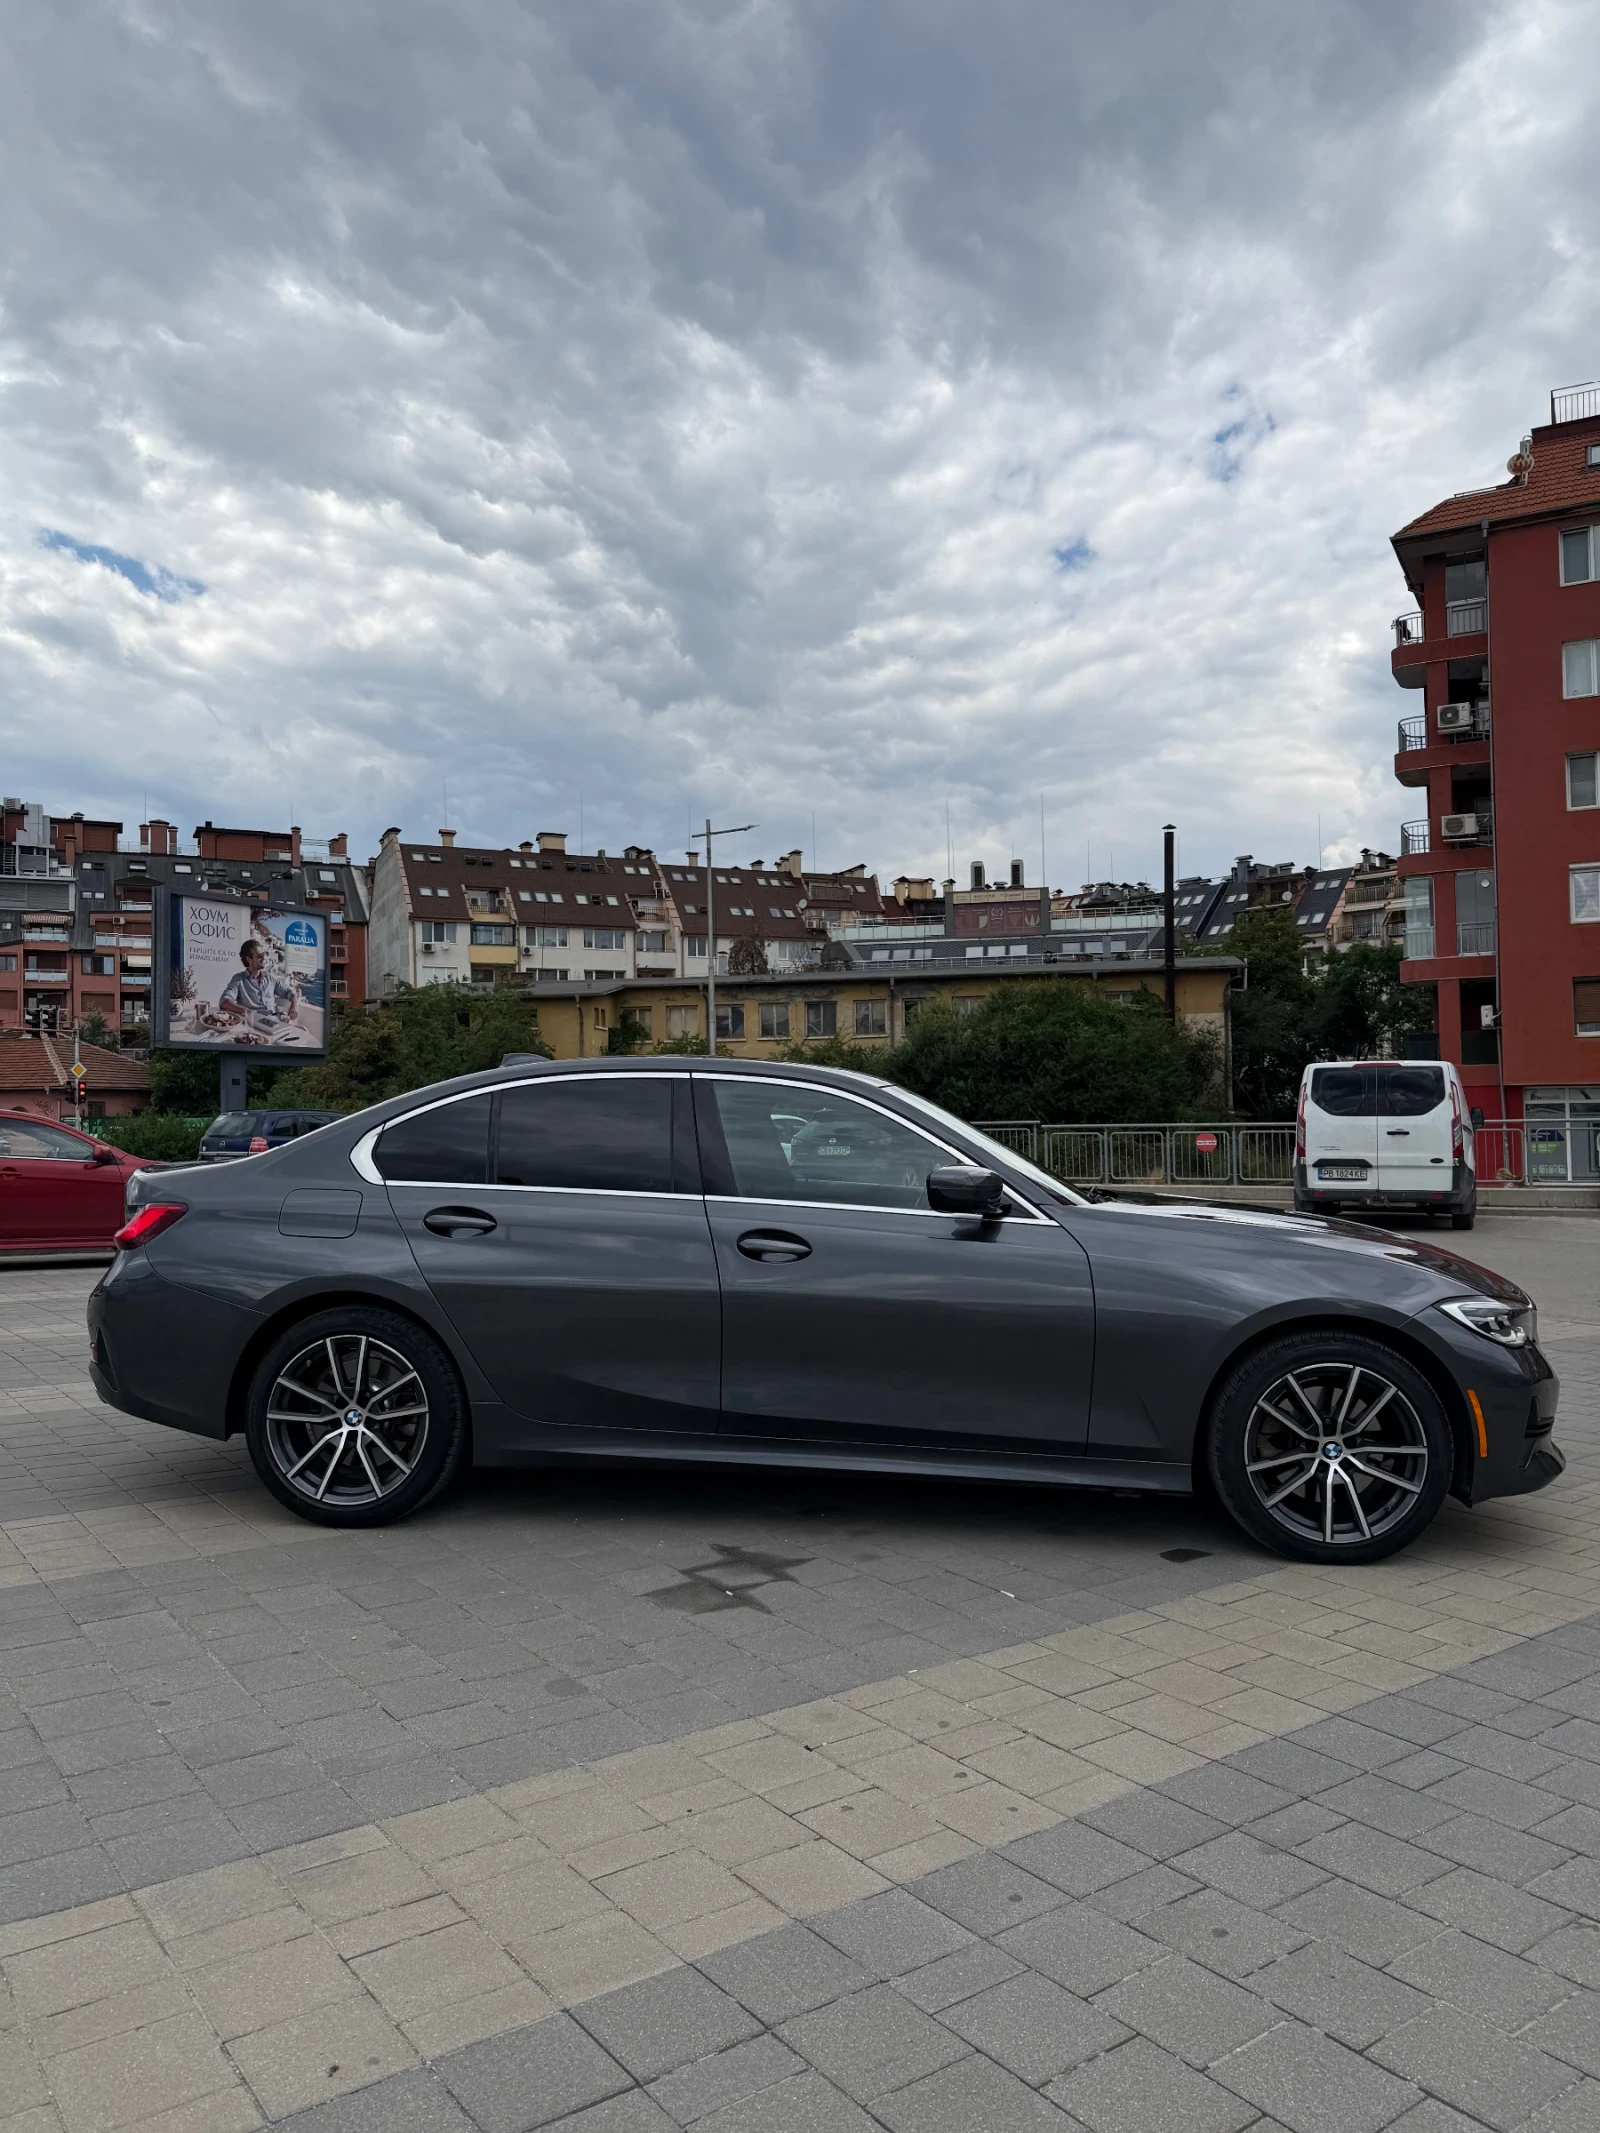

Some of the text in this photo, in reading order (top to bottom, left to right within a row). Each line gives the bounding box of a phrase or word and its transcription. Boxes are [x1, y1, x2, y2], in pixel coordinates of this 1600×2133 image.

[190, 906, 229, 924] ХОУМ
[190, 922, 236, 940] ОФИС
[288, 935, 315, 945] PARALIA
[1324, 1169, 1366, 1178] PB 1824 KE
